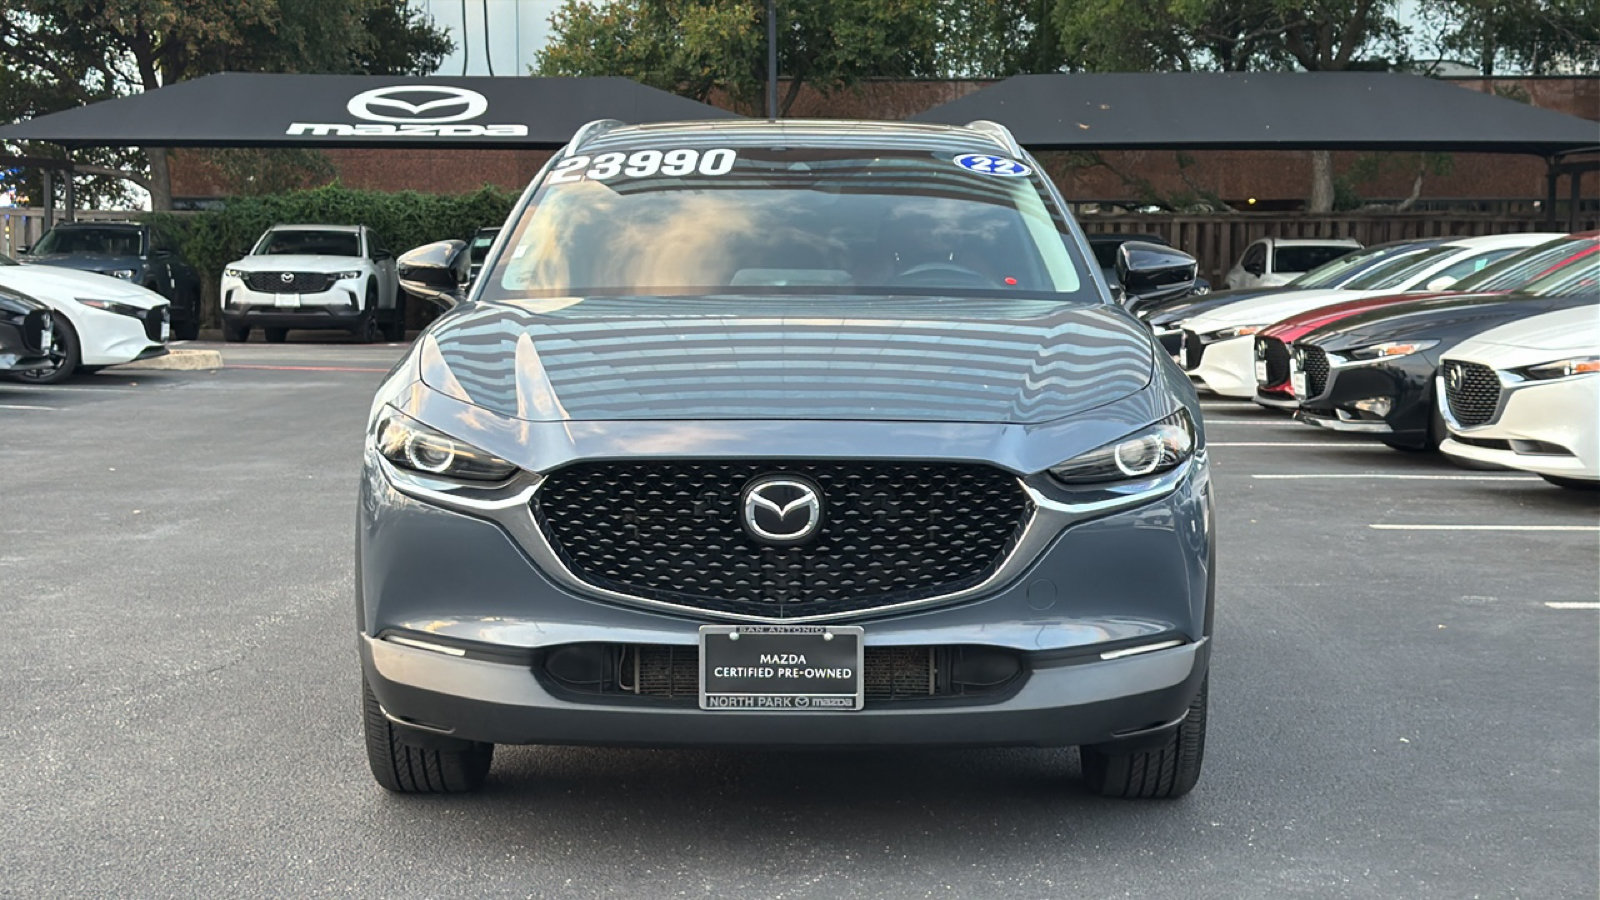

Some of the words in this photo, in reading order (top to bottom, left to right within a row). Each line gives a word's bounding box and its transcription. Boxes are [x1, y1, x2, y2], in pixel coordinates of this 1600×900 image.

[286, 122, 529, 136] mazda
[548, 148, 737, 185] 23990
[970, 156, 1016, 174] 22
[760, 654, 807, 665] MAZDA
[714, 667, 774, 678] CERTIFIED
[778, 668, 852, 679] PRE-OWNED
[709, 697, 754, 707] NORTH
[758, 697, 792, 707] PARK
[812, 698, 853, 707] mazda
